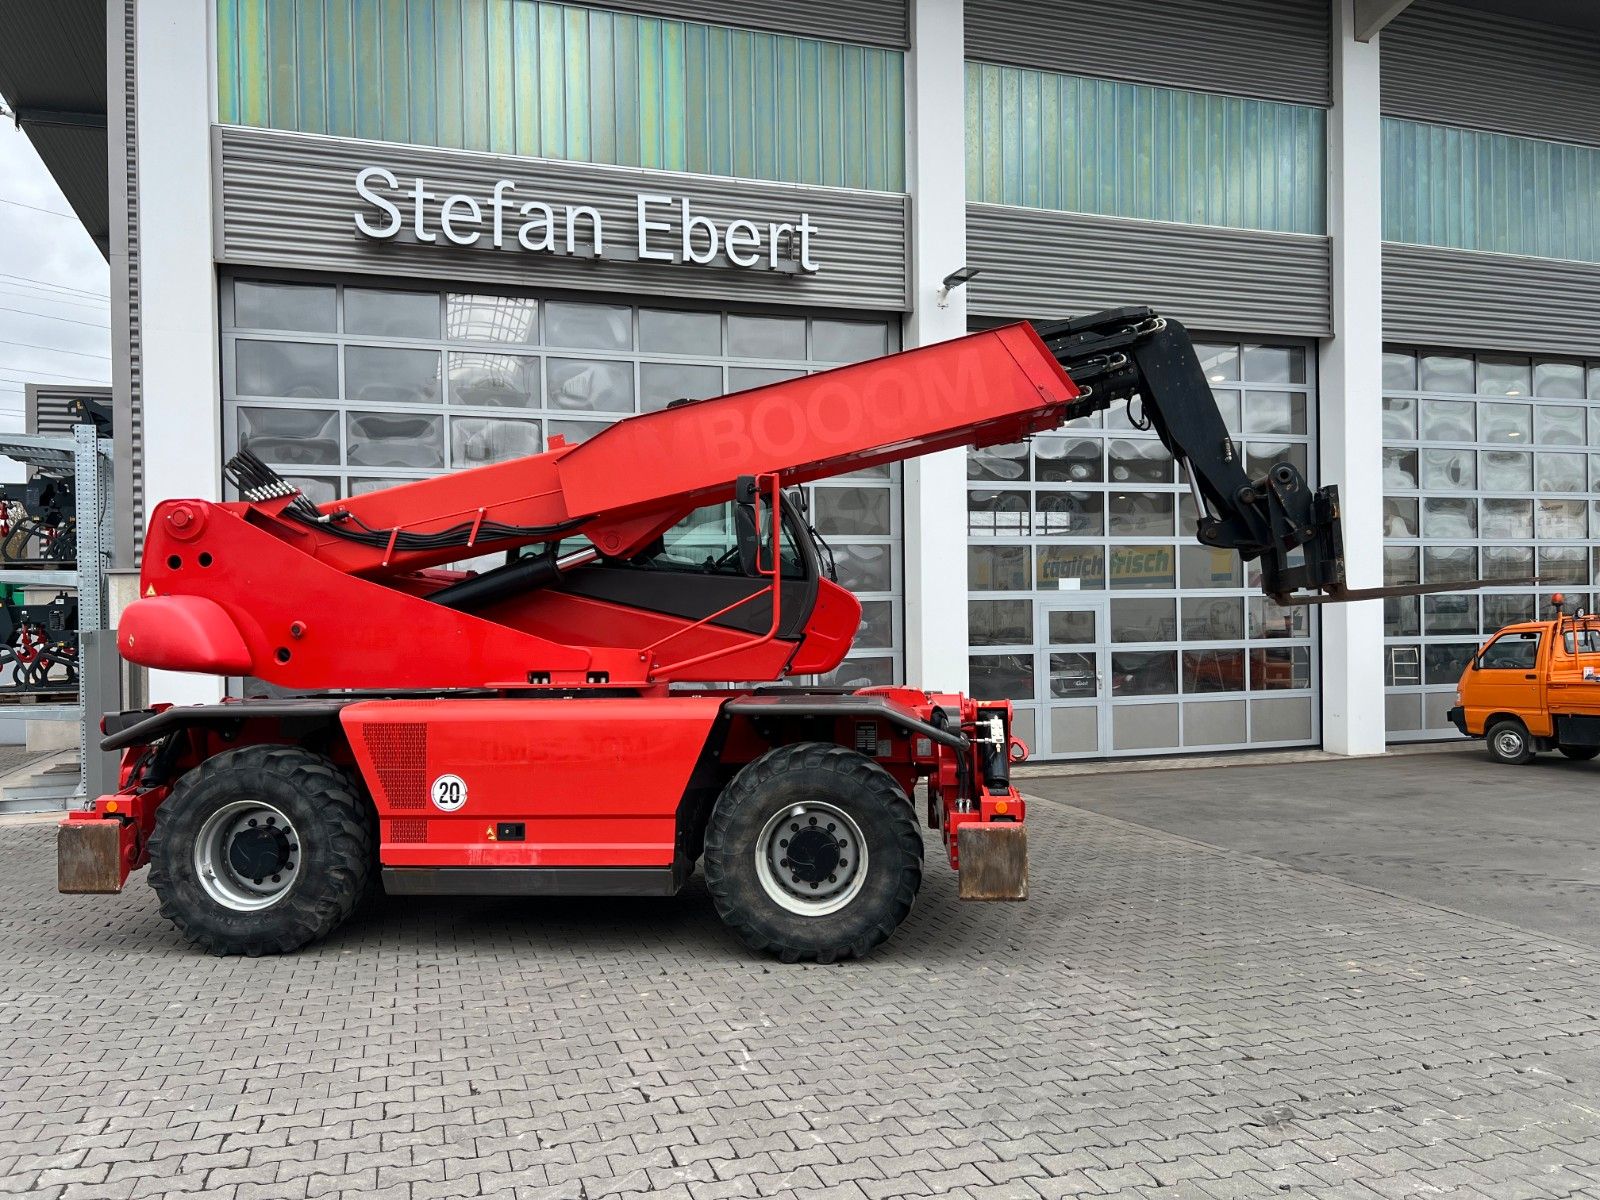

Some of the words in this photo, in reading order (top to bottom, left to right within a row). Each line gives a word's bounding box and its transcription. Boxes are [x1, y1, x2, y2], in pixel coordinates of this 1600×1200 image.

[355, 167, 602, 256] Stefan
[638, 194, 820, 271] Ebert
[439, 781, 460, 804] 20
